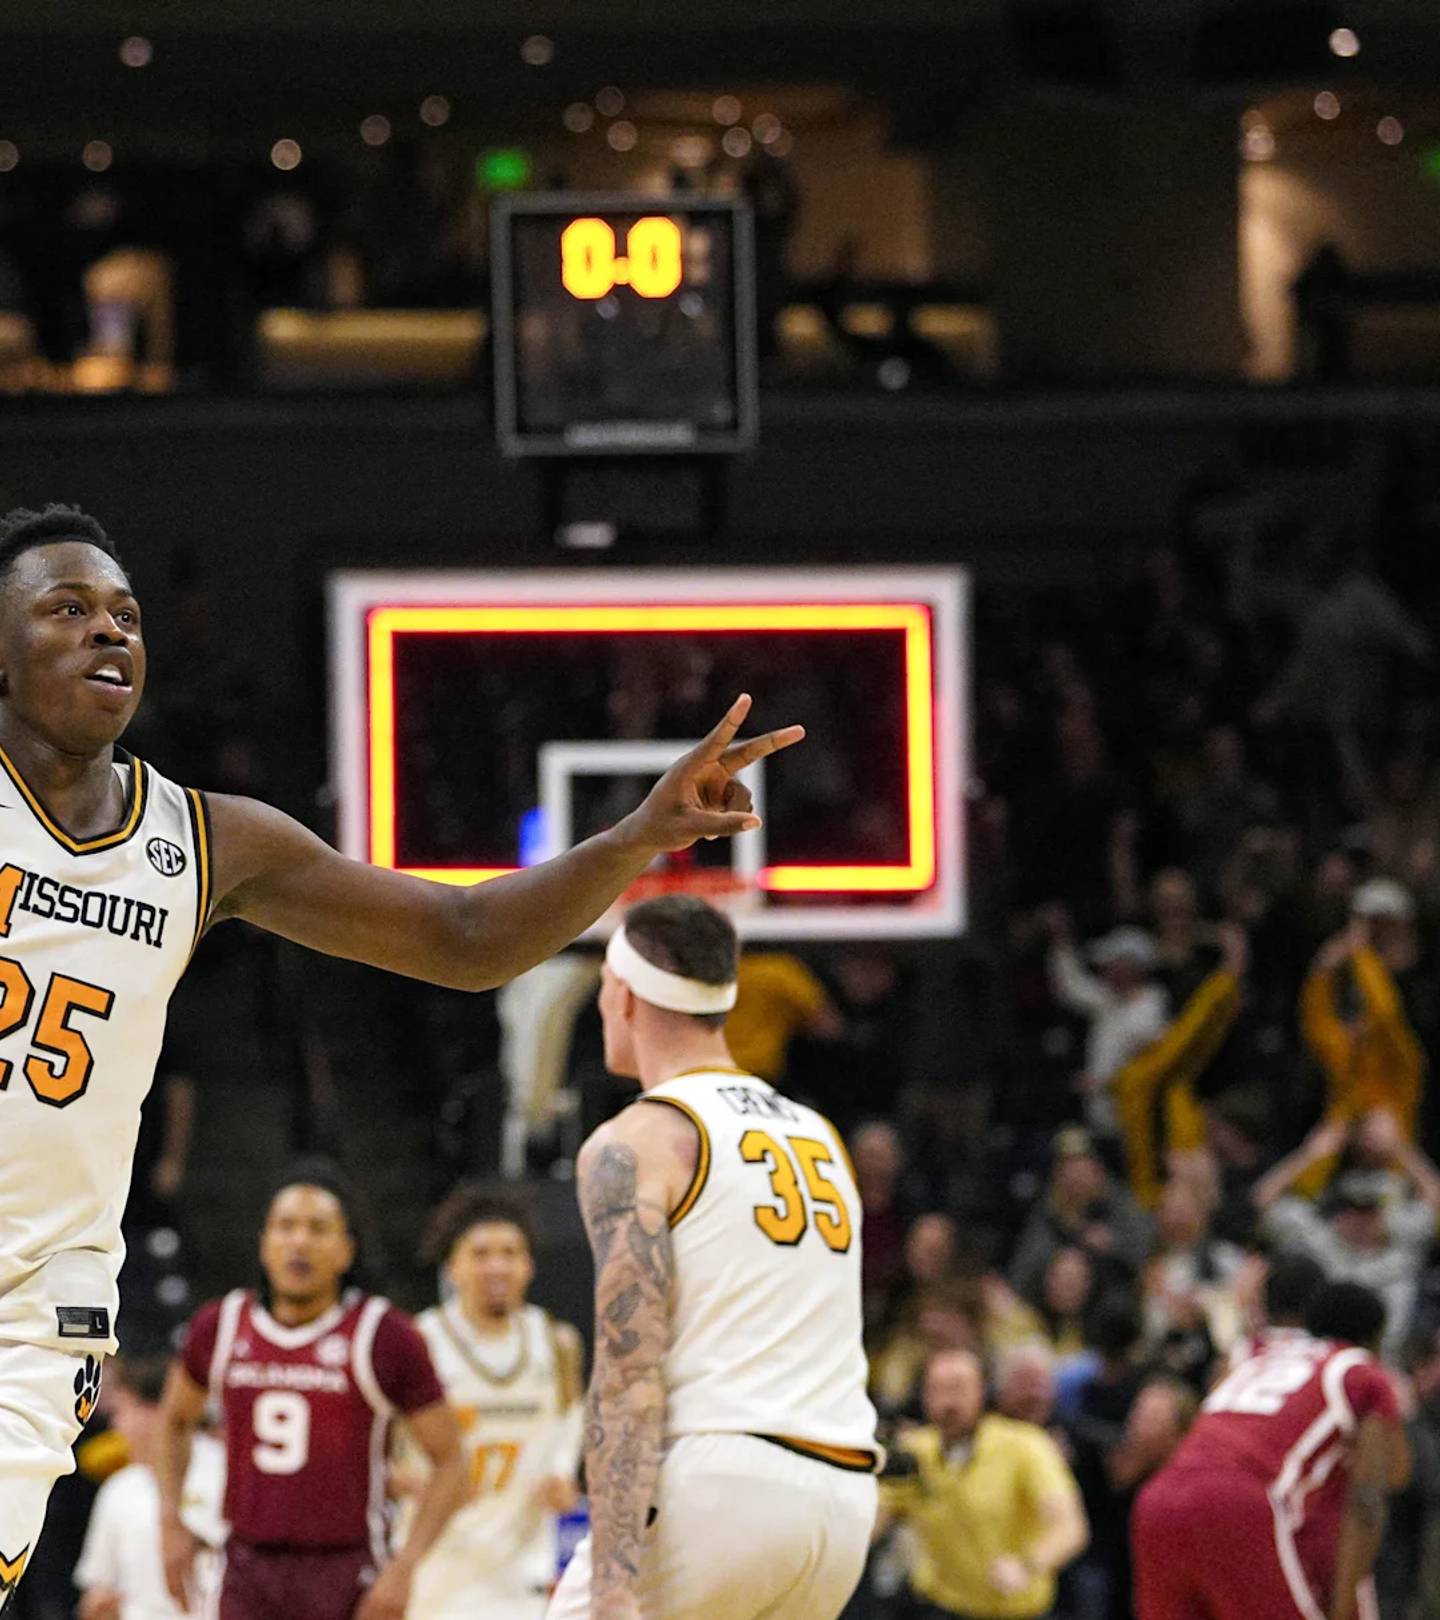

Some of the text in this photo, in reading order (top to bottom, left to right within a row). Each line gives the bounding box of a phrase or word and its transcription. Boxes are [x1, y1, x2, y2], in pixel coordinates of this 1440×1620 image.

[561, 217, 682, 299] 0.0
[149, 840, 184, 874] SEC
[739, 1129, 853, 1254] 35
[252, 1390, 310, 1475] 9
